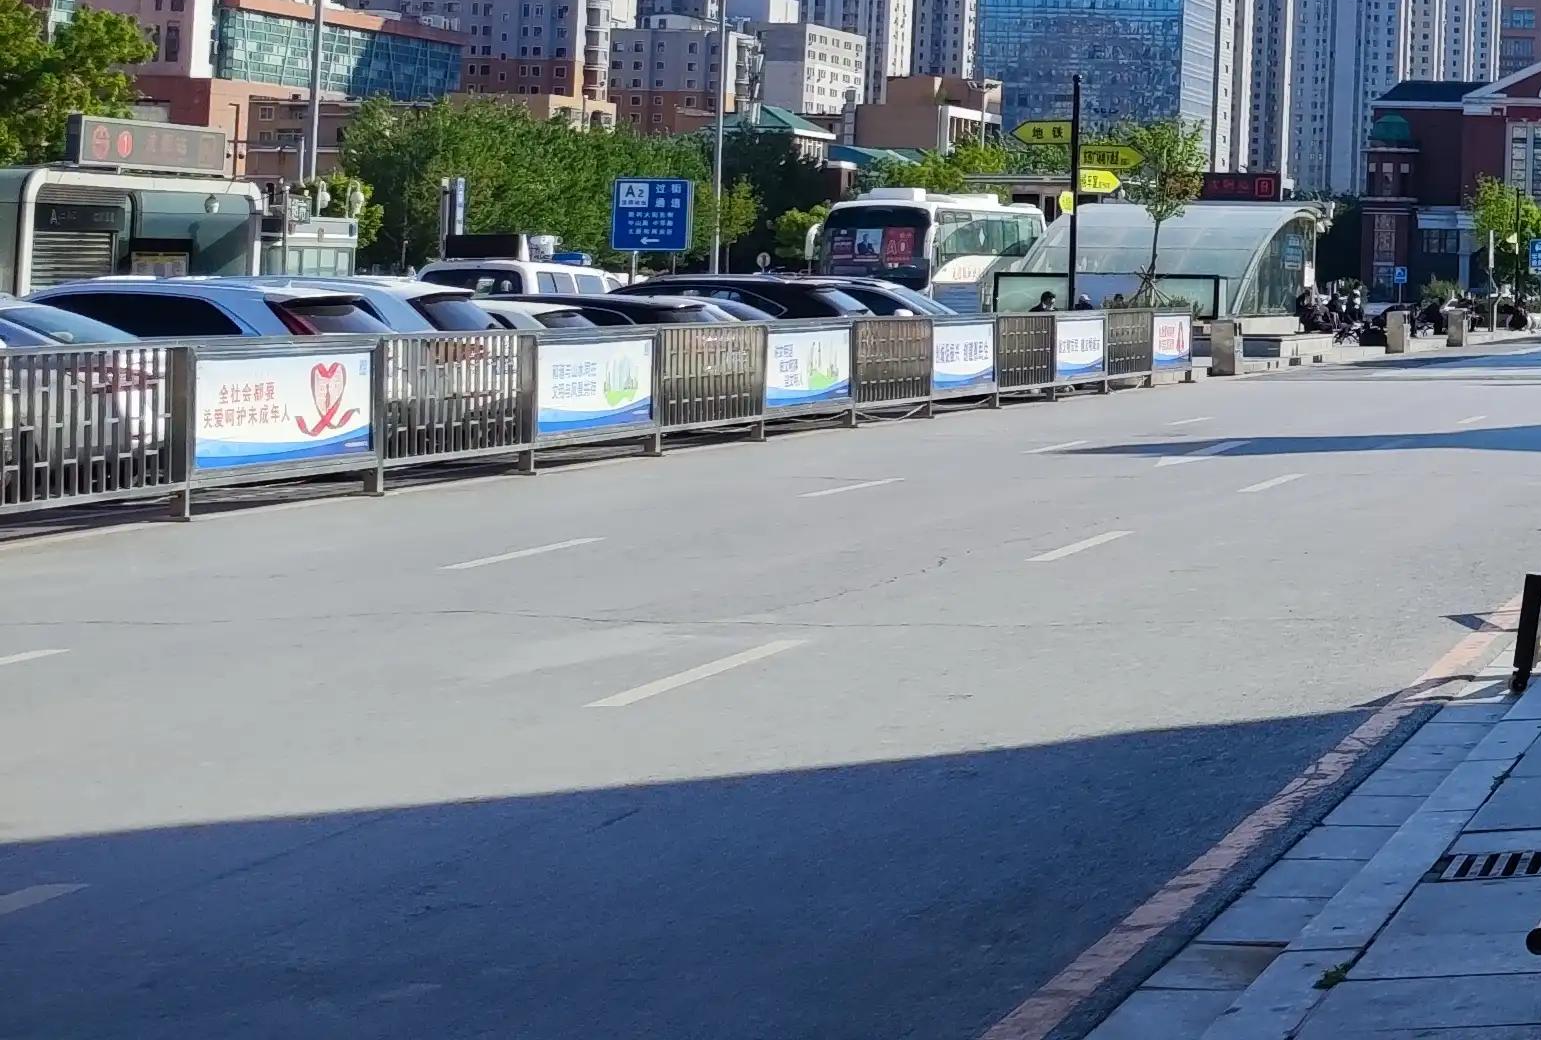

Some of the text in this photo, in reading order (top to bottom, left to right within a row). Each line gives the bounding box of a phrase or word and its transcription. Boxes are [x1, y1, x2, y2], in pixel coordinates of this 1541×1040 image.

[218, 381, 276, 405] 全社会都要
[203, 403, 290, 429] 关爱呵护未成年人
